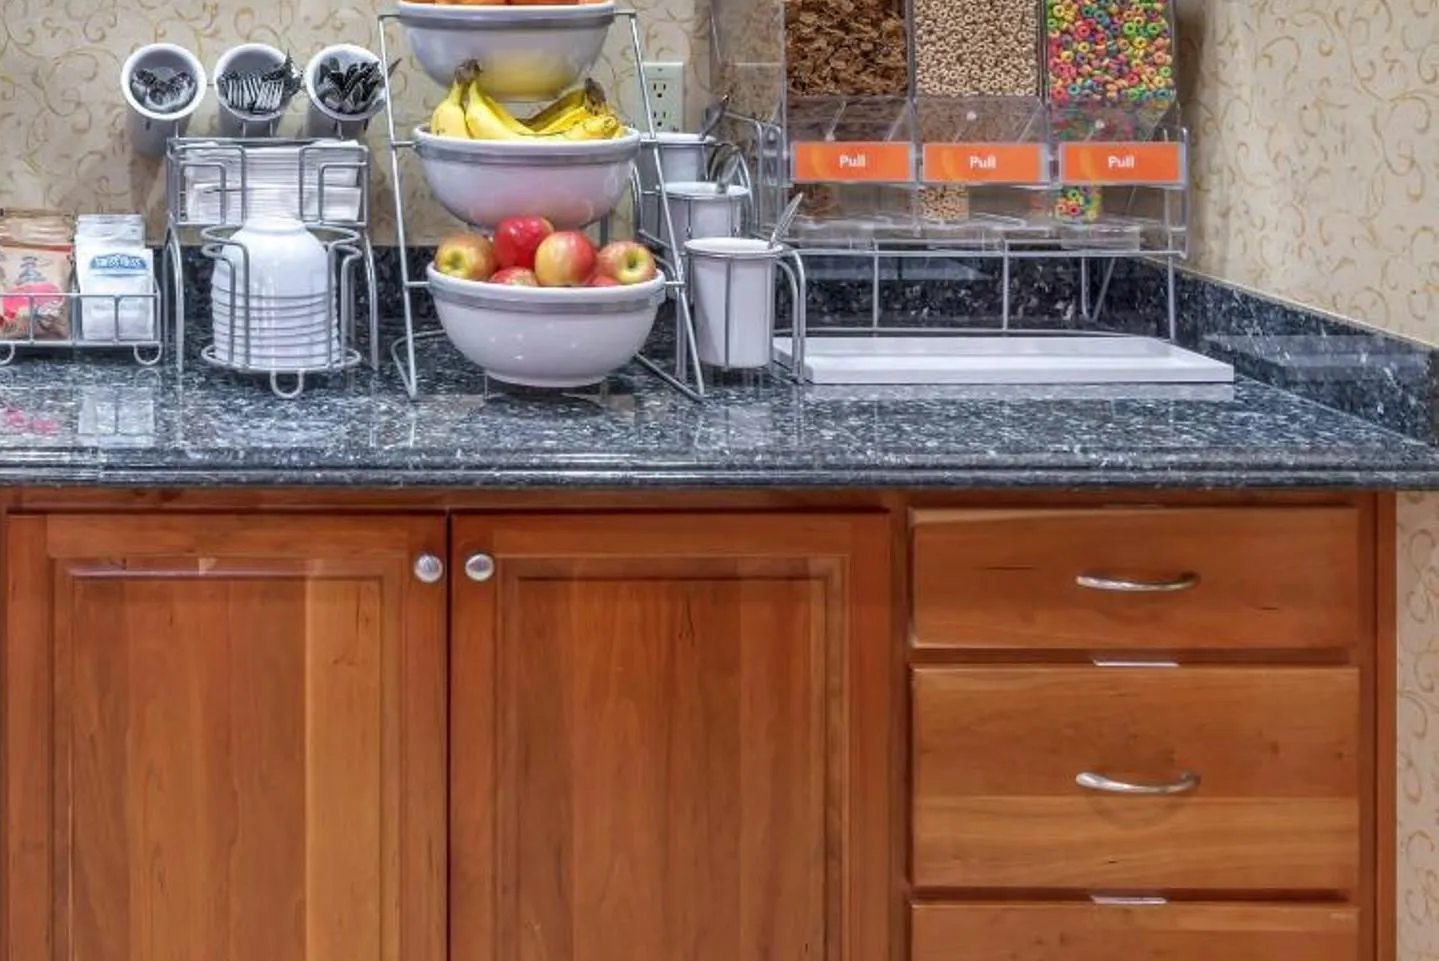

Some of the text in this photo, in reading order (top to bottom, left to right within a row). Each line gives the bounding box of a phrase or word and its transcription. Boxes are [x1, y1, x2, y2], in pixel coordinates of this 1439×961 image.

[839, 154, 867, 169] Pull
[969, 155, 997, 170] Pull
[1107, 154, 1135, 169] Pull
